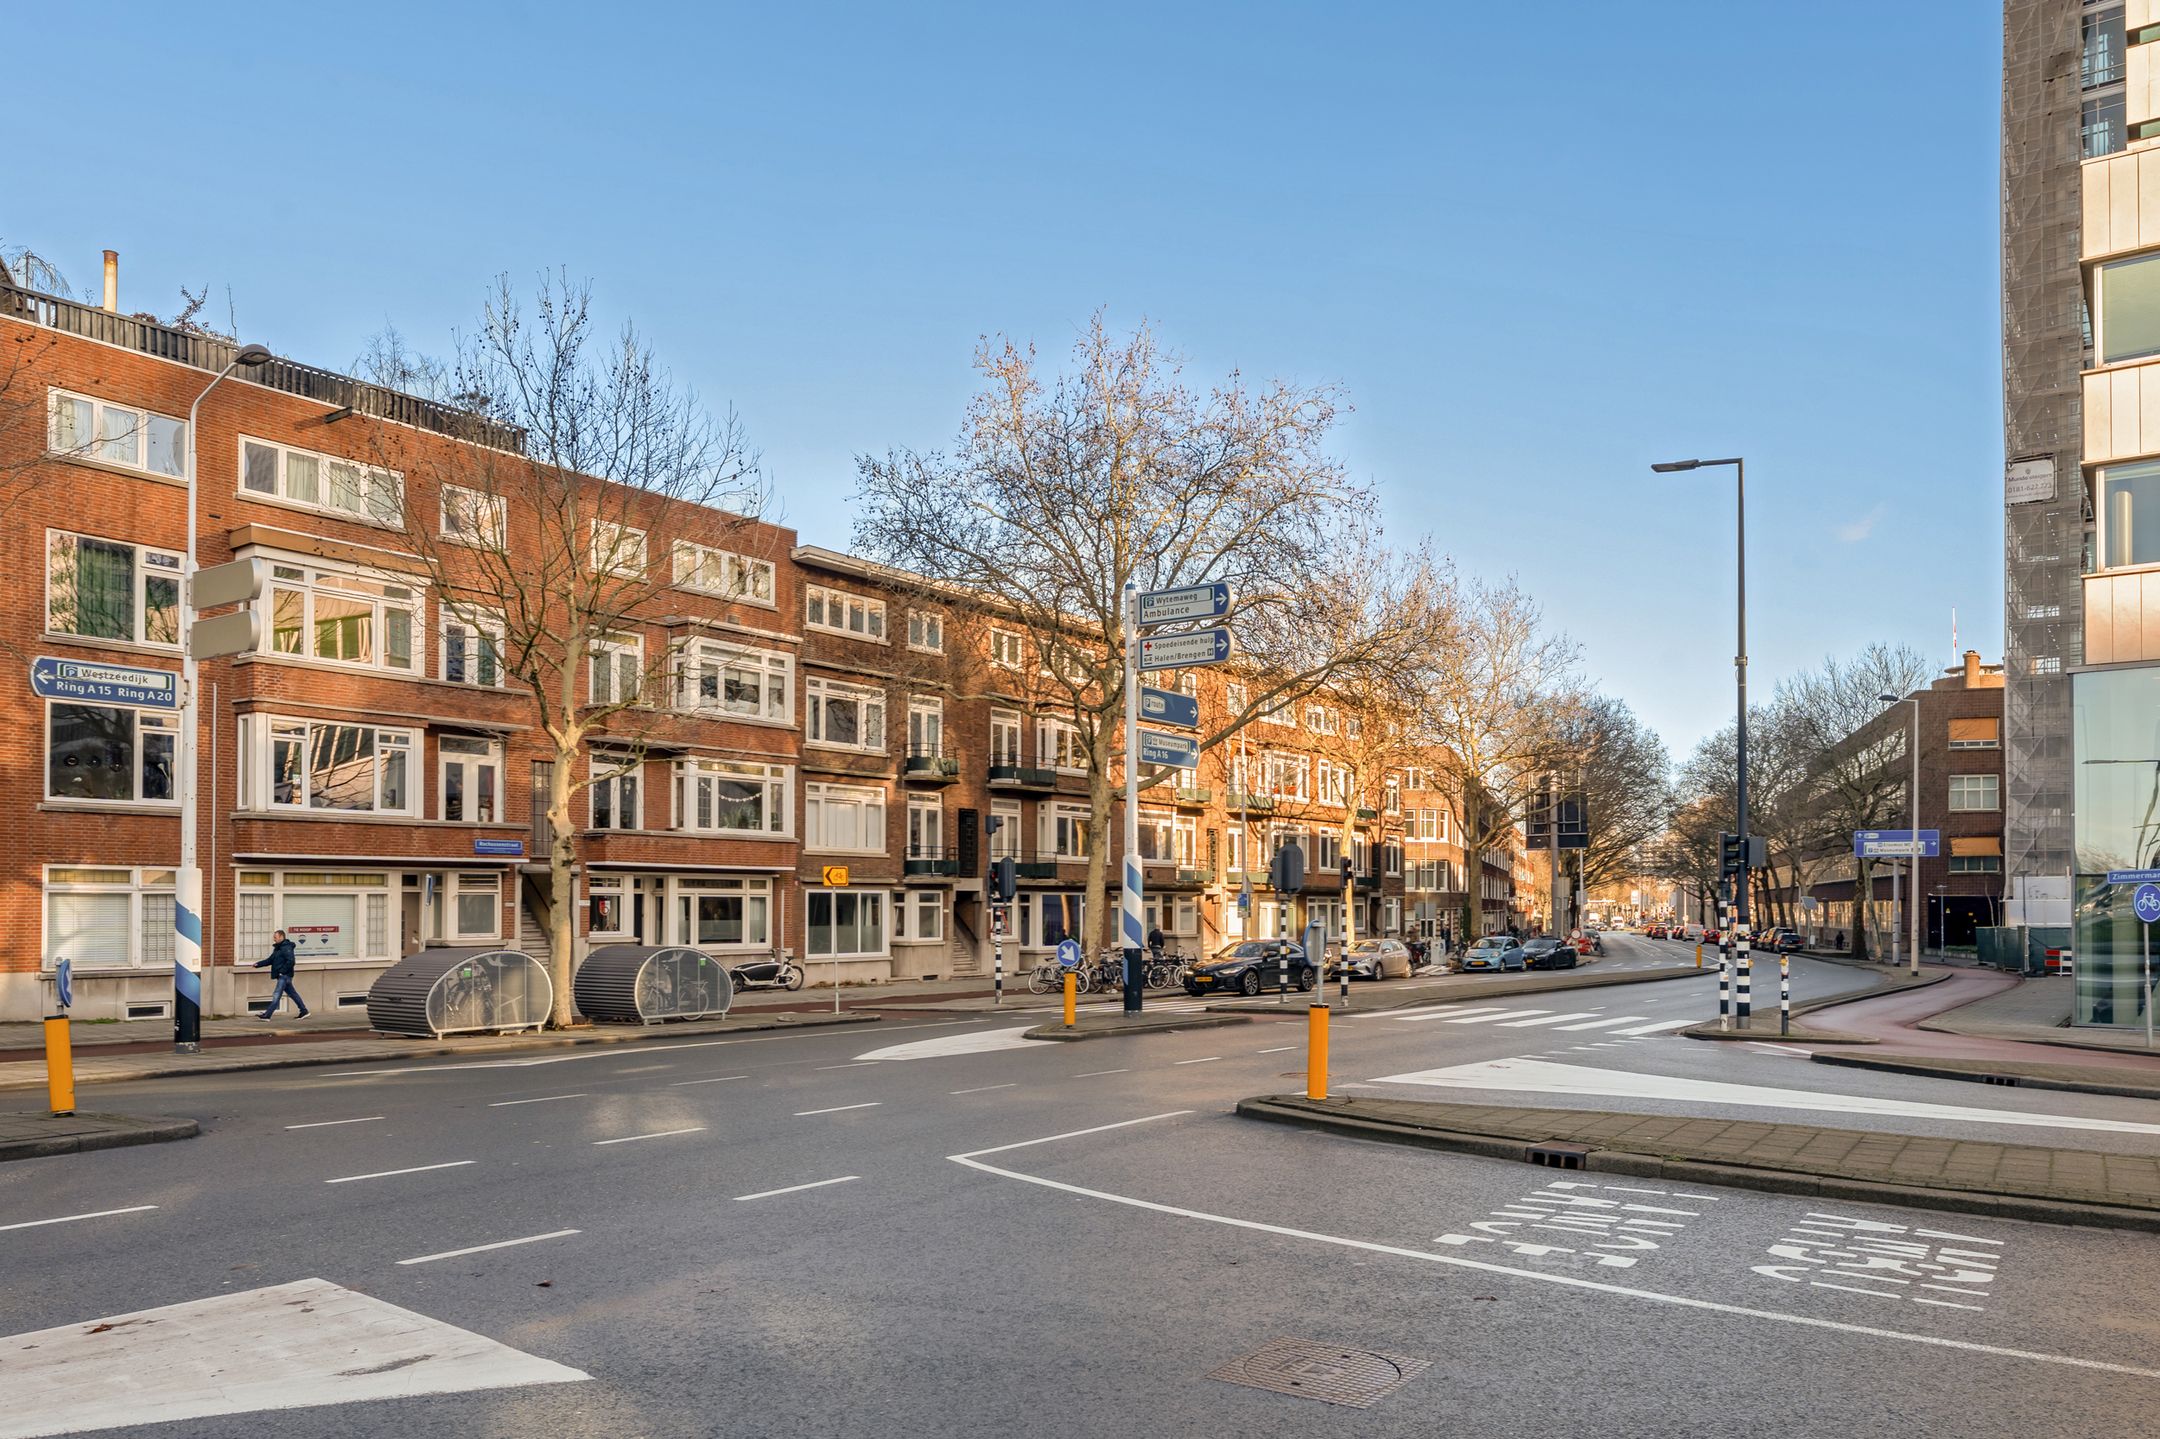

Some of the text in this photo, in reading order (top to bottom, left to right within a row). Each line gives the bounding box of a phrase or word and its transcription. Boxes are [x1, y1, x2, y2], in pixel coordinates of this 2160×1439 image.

[1156, 593, 1198, 605] Wytemaweg
[1143, 606, 1190, 618] Ambulance
[1154, 636, 1214, 651] Spoedeisende hulp
[1154, 650, 1206, 662] Halen/Brengen
[81, 668, 148, 684] Westzeedijk
[57, 681, 112, 695] Ring A 15
[118, 687, 172, 701] Ring A 20
[1143, 747, 1156, 760] Ring
[1157, 749, 1162, 759] A
[1433, 1181, 1720, 1268] LANCE
[1750, 1212, 2005, 1312] AMBU
